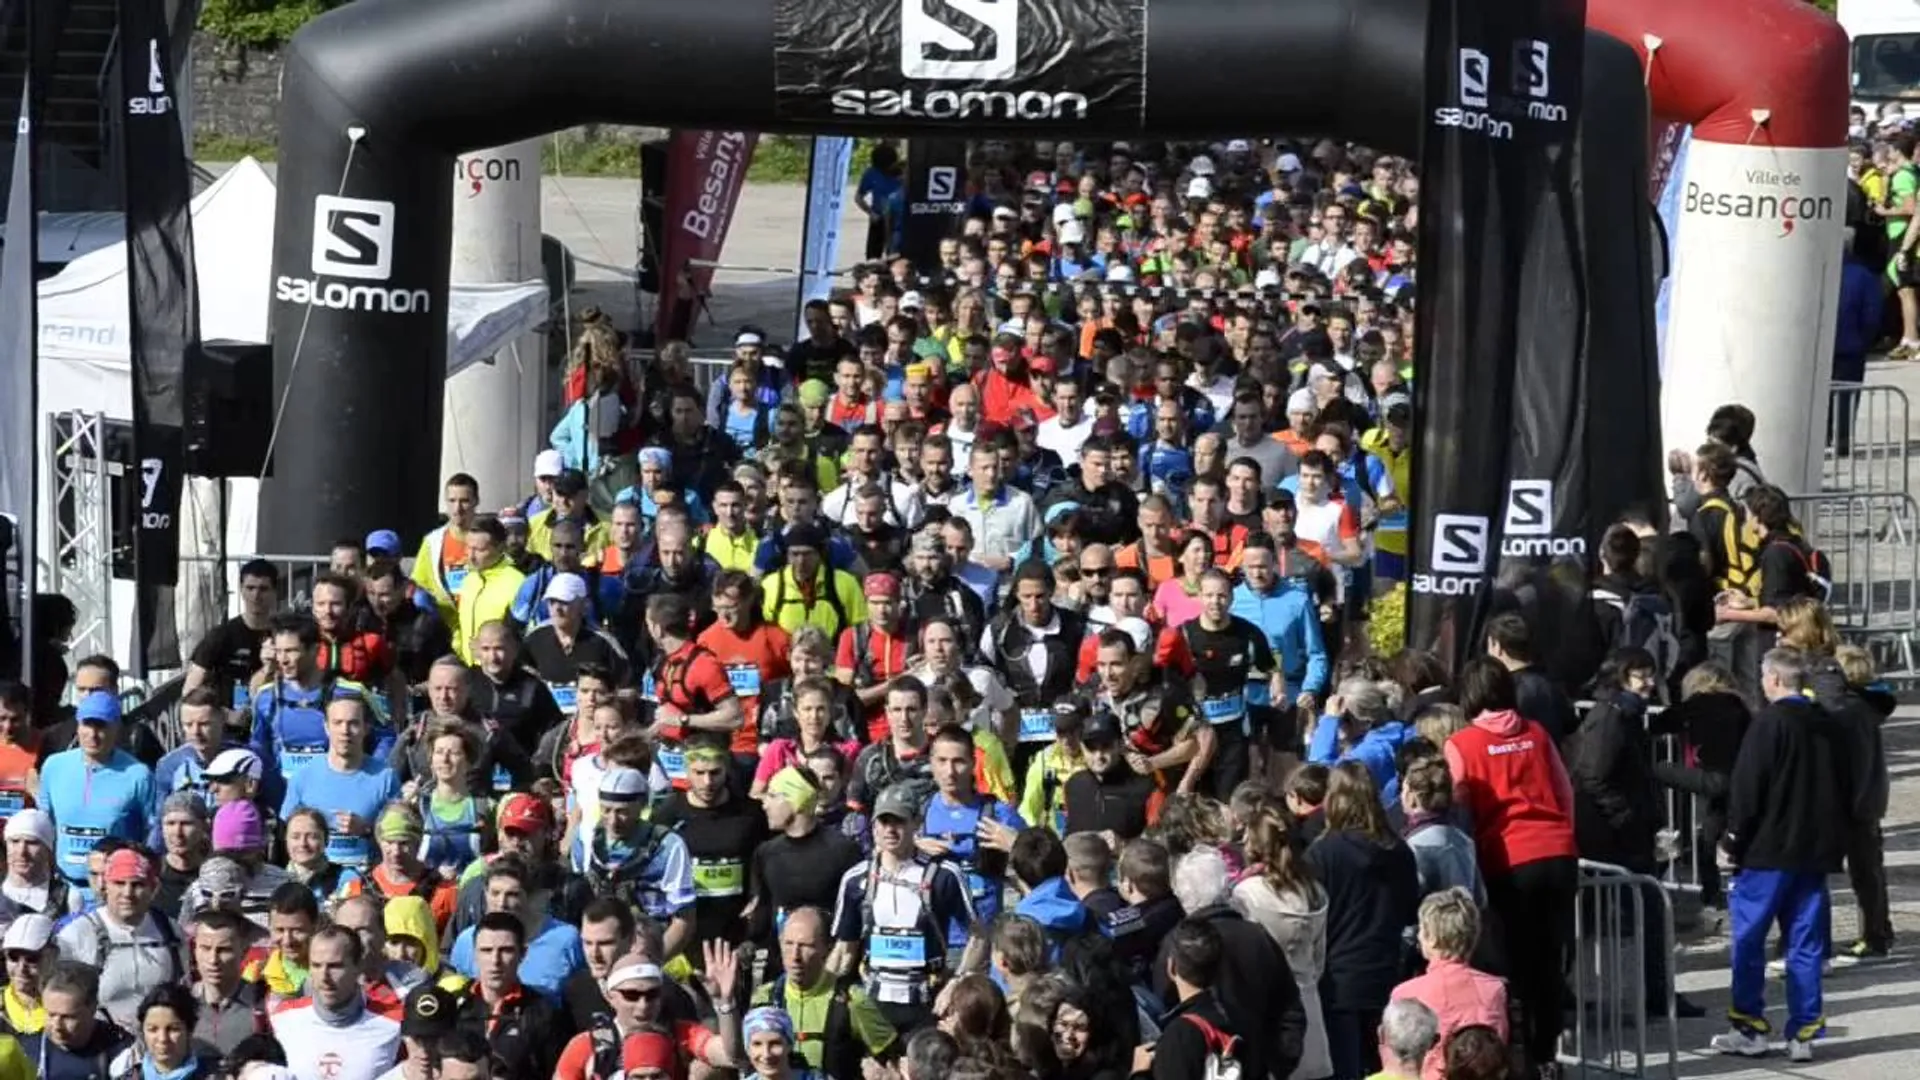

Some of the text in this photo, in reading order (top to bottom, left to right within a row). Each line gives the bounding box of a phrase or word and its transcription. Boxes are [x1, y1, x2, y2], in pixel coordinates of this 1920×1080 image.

[832, 88, 1087, 119] salomon
[1745, 169, 1801, 186] Ville de
[1685, 181, 1833, 239] Besançon
[276, 275, 430, 313] salomon
